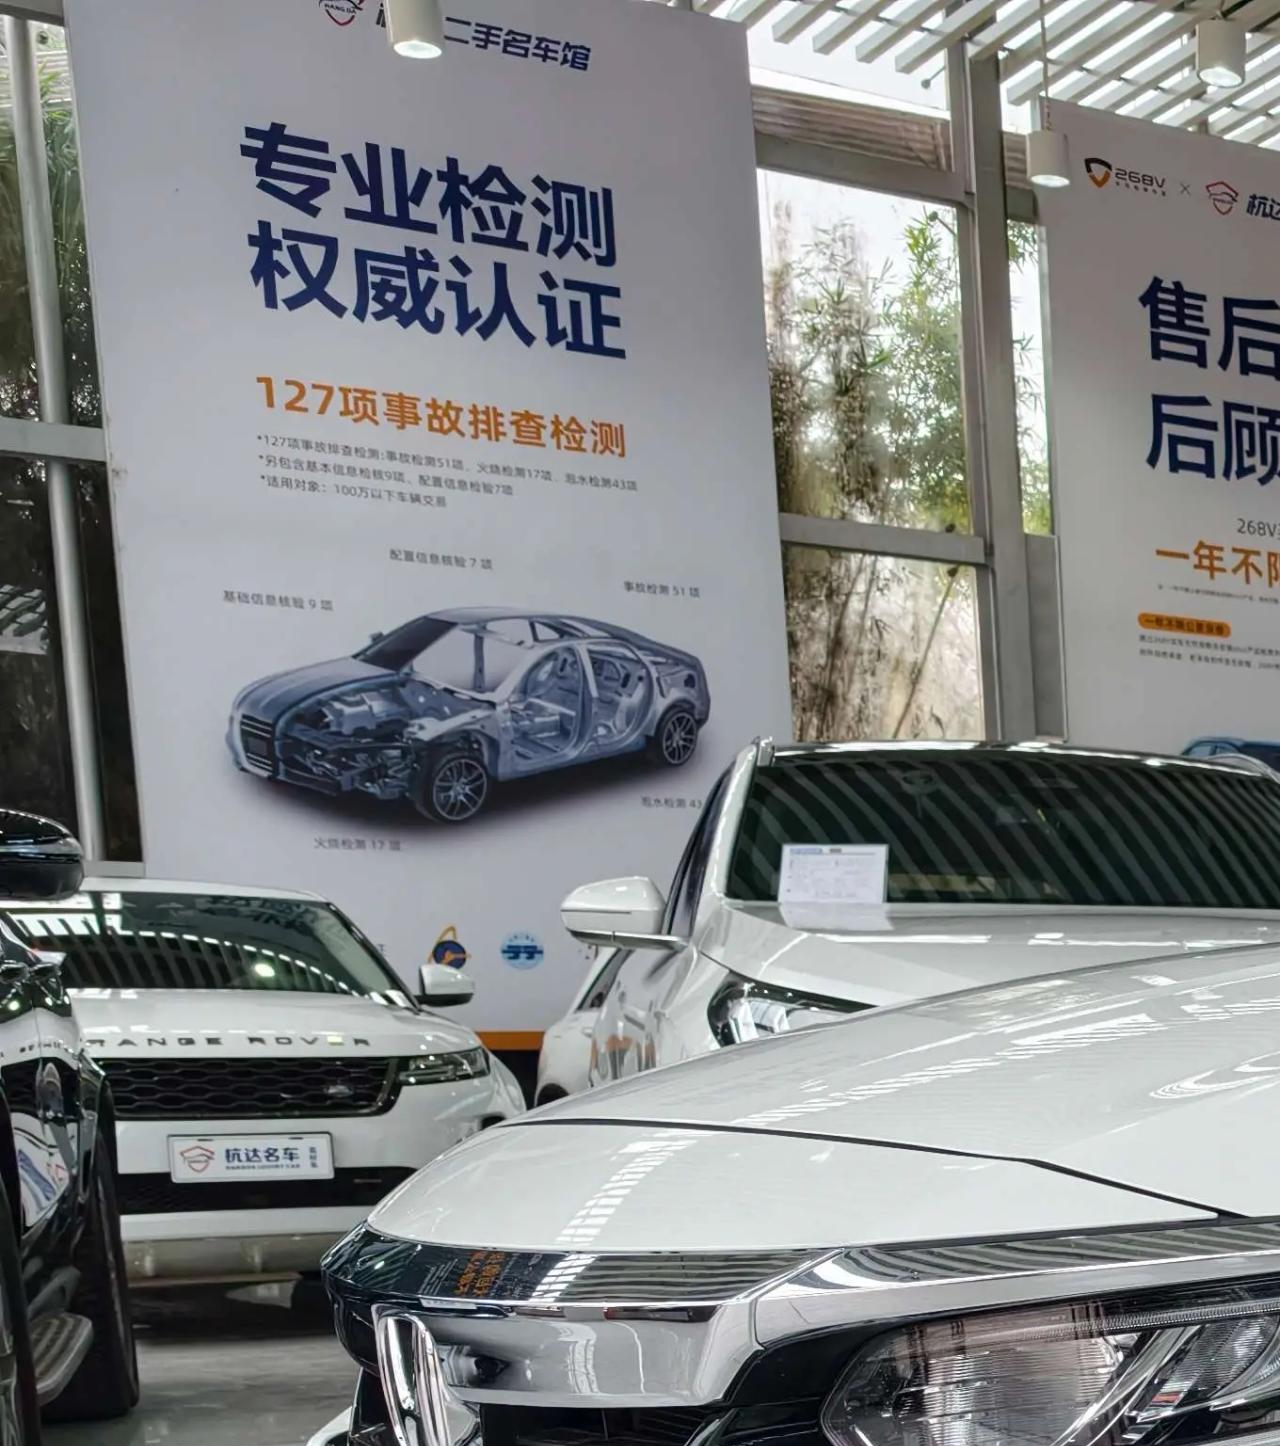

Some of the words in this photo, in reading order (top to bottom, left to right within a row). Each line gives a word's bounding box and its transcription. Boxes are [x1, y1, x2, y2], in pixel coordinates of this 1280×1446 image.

[376, 3, 592, 72] 二手名车馆
[239, 121, 619, 268] 专业检测
[1114, 167, 1167, 189] 268V
[247, 219, 627, 361] 权威认证
[256, 376, 627, 459] 127项事故排查检测
[224, 1147, 301, 1164] 杭达名车
